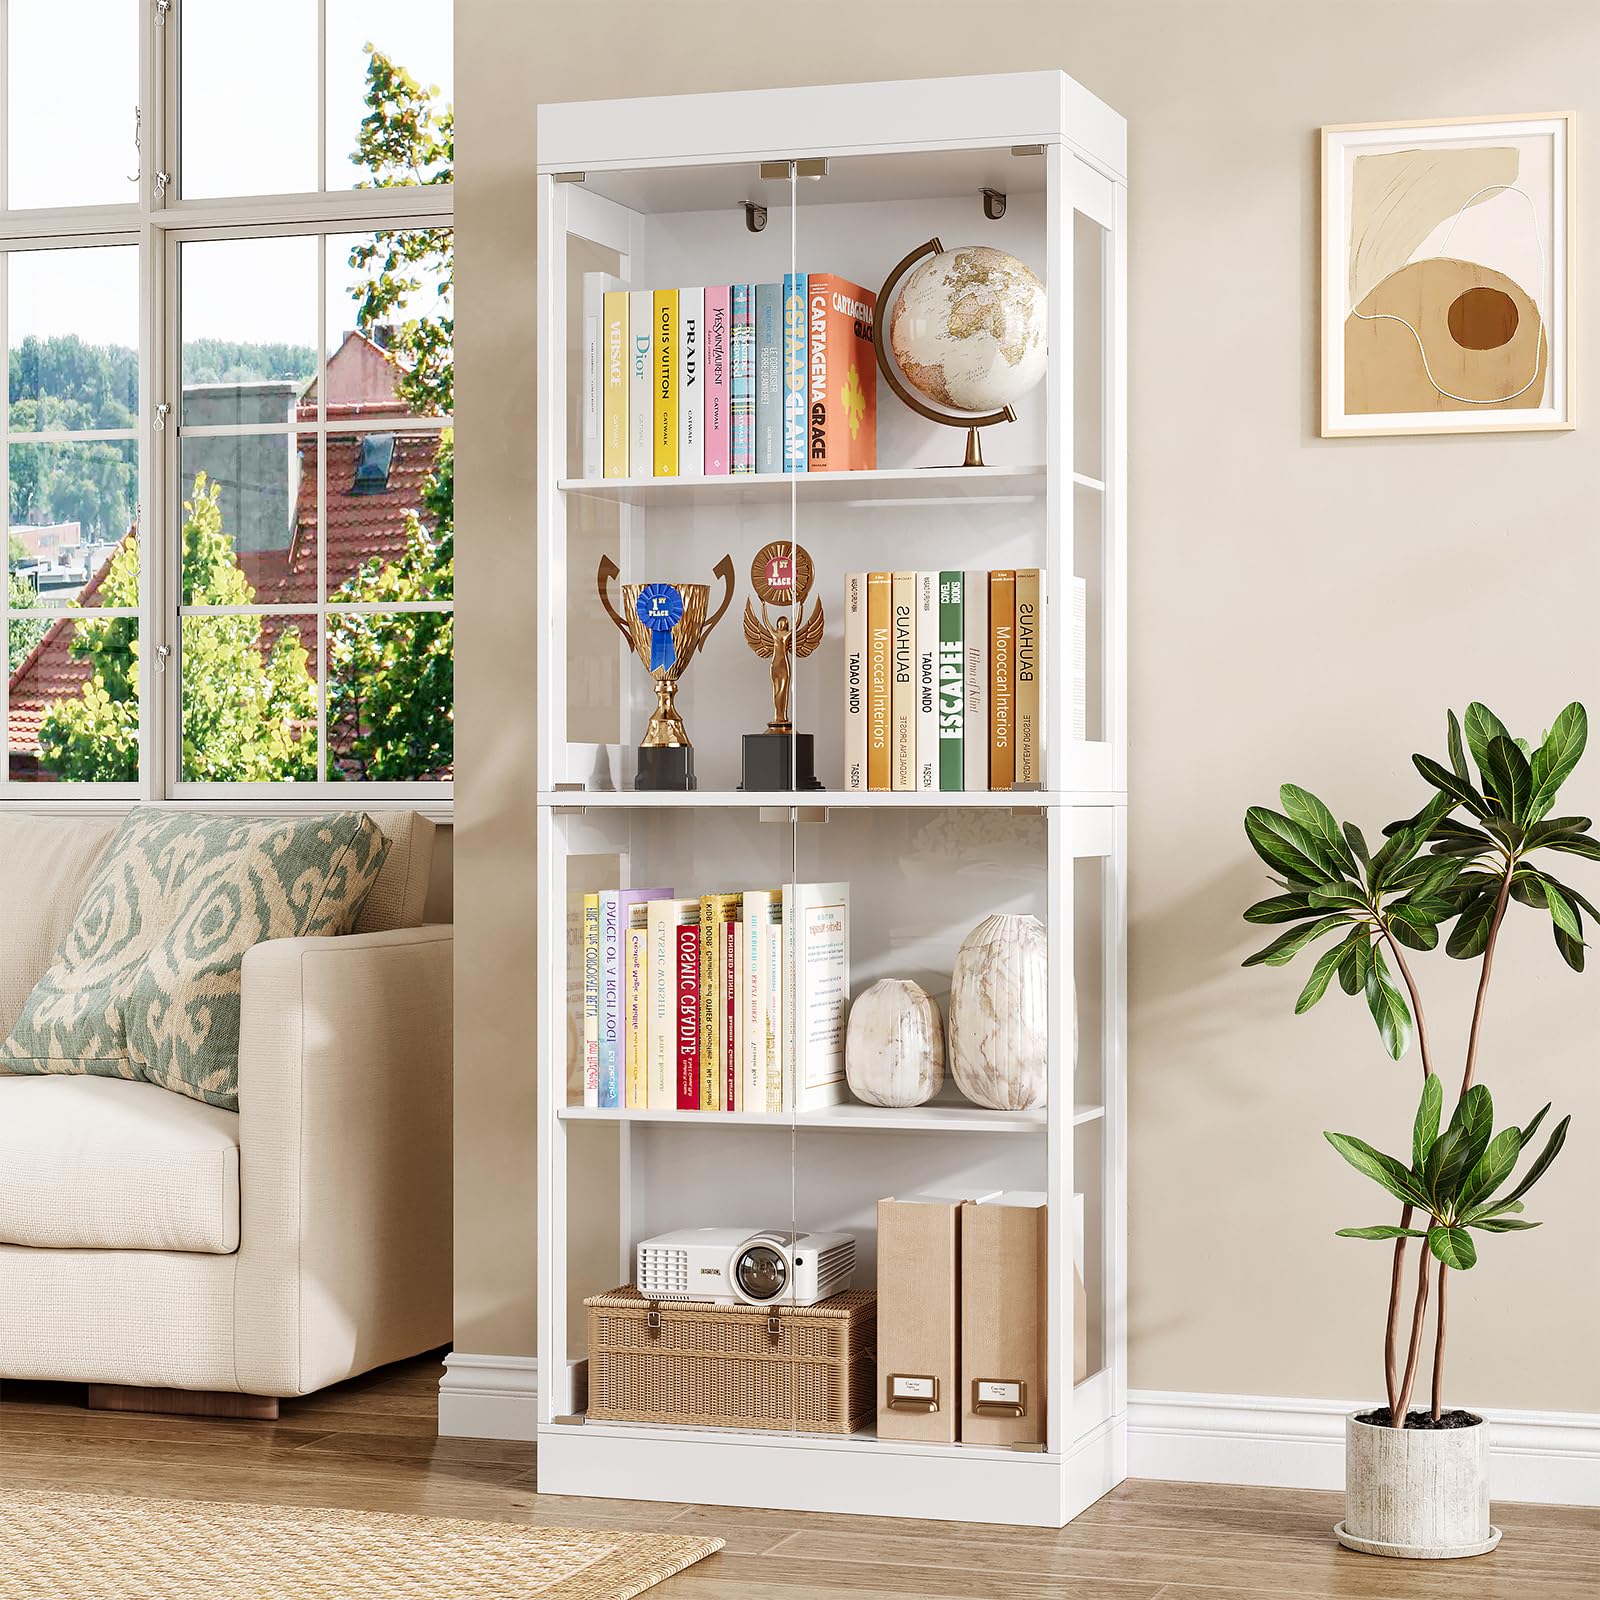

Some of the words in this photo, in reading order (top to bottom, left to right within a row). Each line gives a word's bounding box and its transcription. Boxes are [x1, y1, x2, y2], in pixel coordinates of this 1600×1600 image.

[662, 307, 670, 343] LOUIS
[832, 291, 874, 324] CARTAGENA
[741, 326, 751, 371] Vivienne
[811, 296, 827, 403] CARTAGENA
[854, 320, 874, 344] GRAC
[610, 320, 621, 389] VERSACE
[635, 334, 651, 380] Dior
[686, 319, 696, 387] PRADA
[732, 323, 742, 378] Westwood
[760, 347, 769, 369] PIERRE
[769, 347, 778, 356] LE
[662, 346, 670, 399] VUITTON
[760, 370, 769, 406] JEANNERET
[769, 358, 778, 393] CORBUSIER
[811, 402, 826, 460] GRACE
[768, 578, 792, 586] PLACE
[940, 581, 950, 604] COVEL
[951, 581, 961, 604] BOOKS
[849, 652, 859, 686] TADAO
[873, 628, 888, 694] Moroccan
[922, 651, 932, 685] TADAO
[996, 626, 1011, 692] Moroccan
[849, 687, 859, 714] ANDO
[922, 686, 932, 714] ANDO
[872, 694, 888, 749] Interiors
[996, 692, 1011, 748] Interiors
